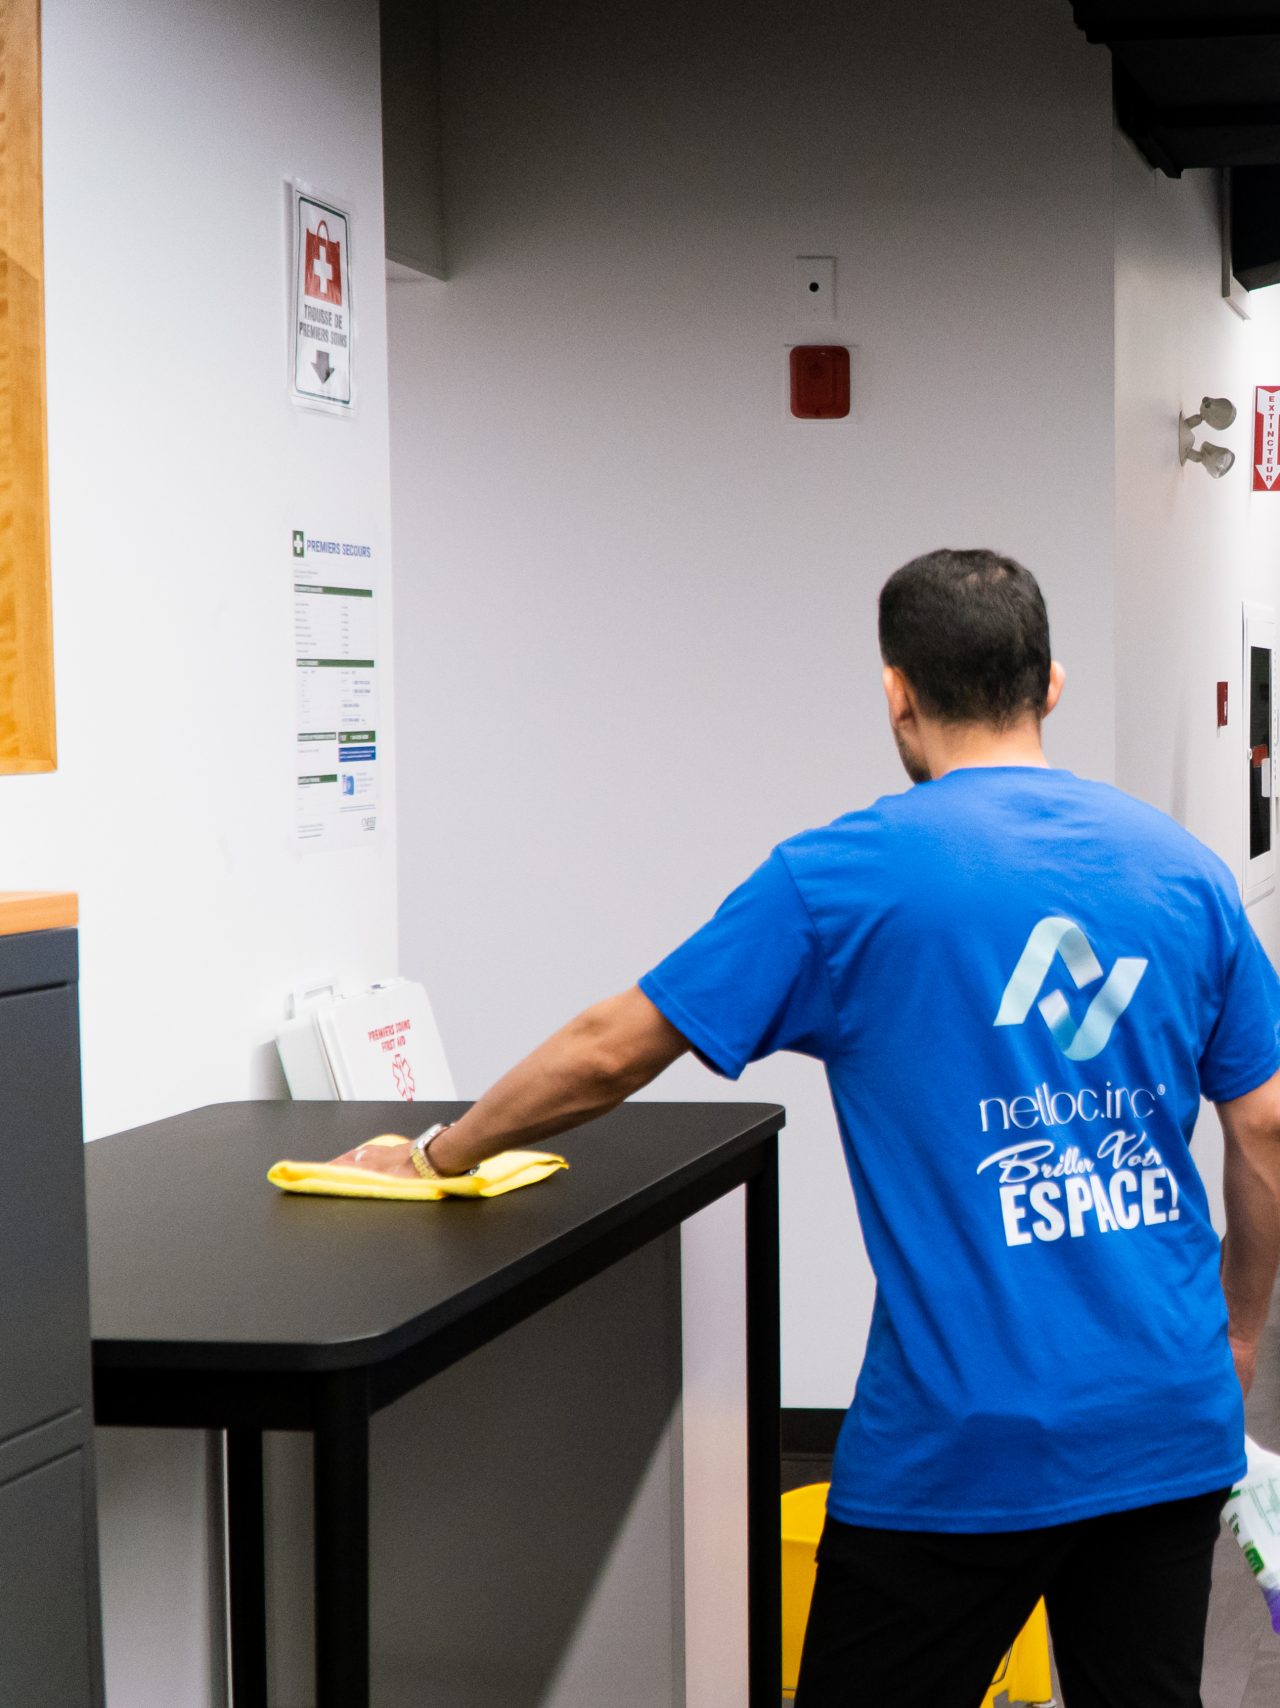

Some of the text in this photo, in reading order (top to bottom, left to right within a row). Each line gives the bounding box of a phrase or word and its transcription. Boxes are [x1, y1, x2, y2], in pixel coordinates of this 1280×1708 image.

[304, 303, 342, 330] TROUSSE DE
[299, 321, 348, 349] PREMIERS SOINS
[1265, 395, 1275, 482] EXTINCTEUR
[306, 539, 372, 559] PREMIERS SECOURS
[998, 1167, 1180, 1247] ESPACE!
